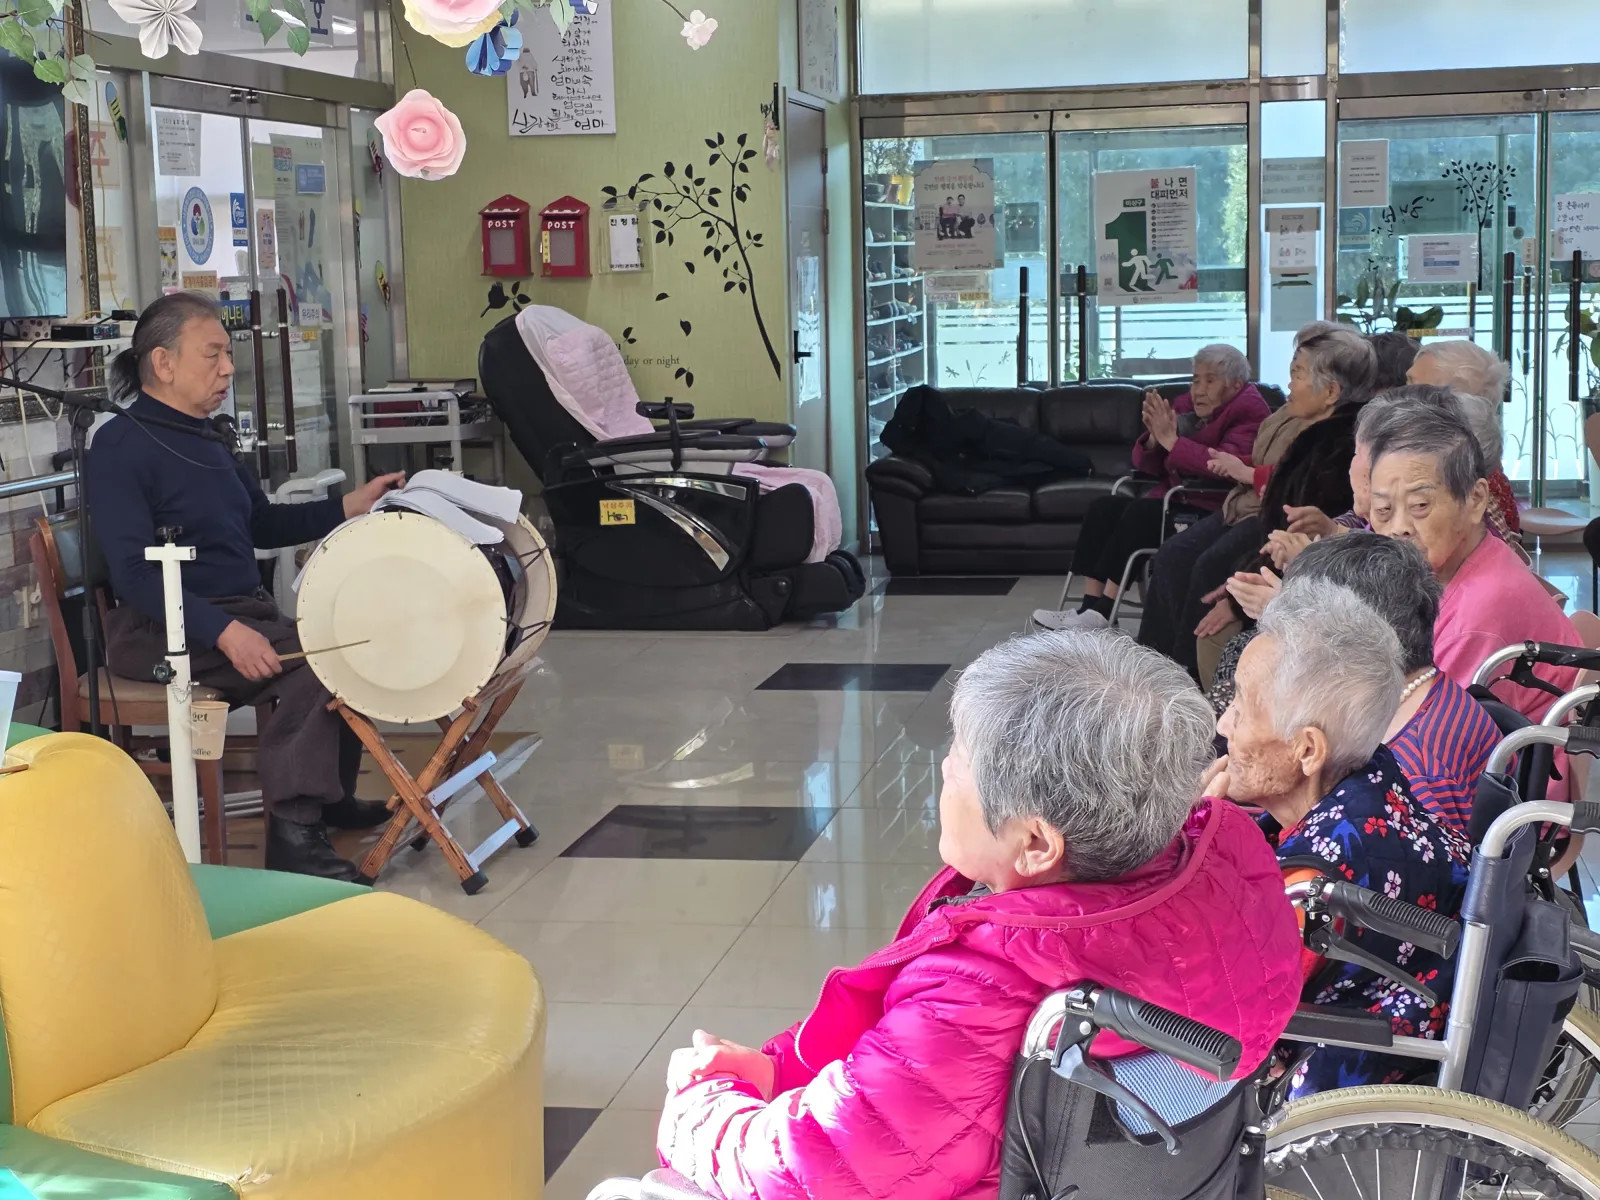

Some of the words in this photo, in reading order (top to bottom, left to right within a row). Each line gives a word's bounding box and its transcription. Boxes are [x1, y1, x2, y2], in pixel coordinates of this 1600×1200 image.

[566, 86, 586, 95] 다시
[575, 118, 609, 130] 엄마
[1150, 188, 1188, 200] 대피먼저
[1125, 199, 1144, 207] 비상구
[488, 220, 515, 228] POST
[547, 221, 575, 229] POST
[624, 355, 639, 368] day
[656, 355, 680, 368] night
[192, 712, 209, 722] get
